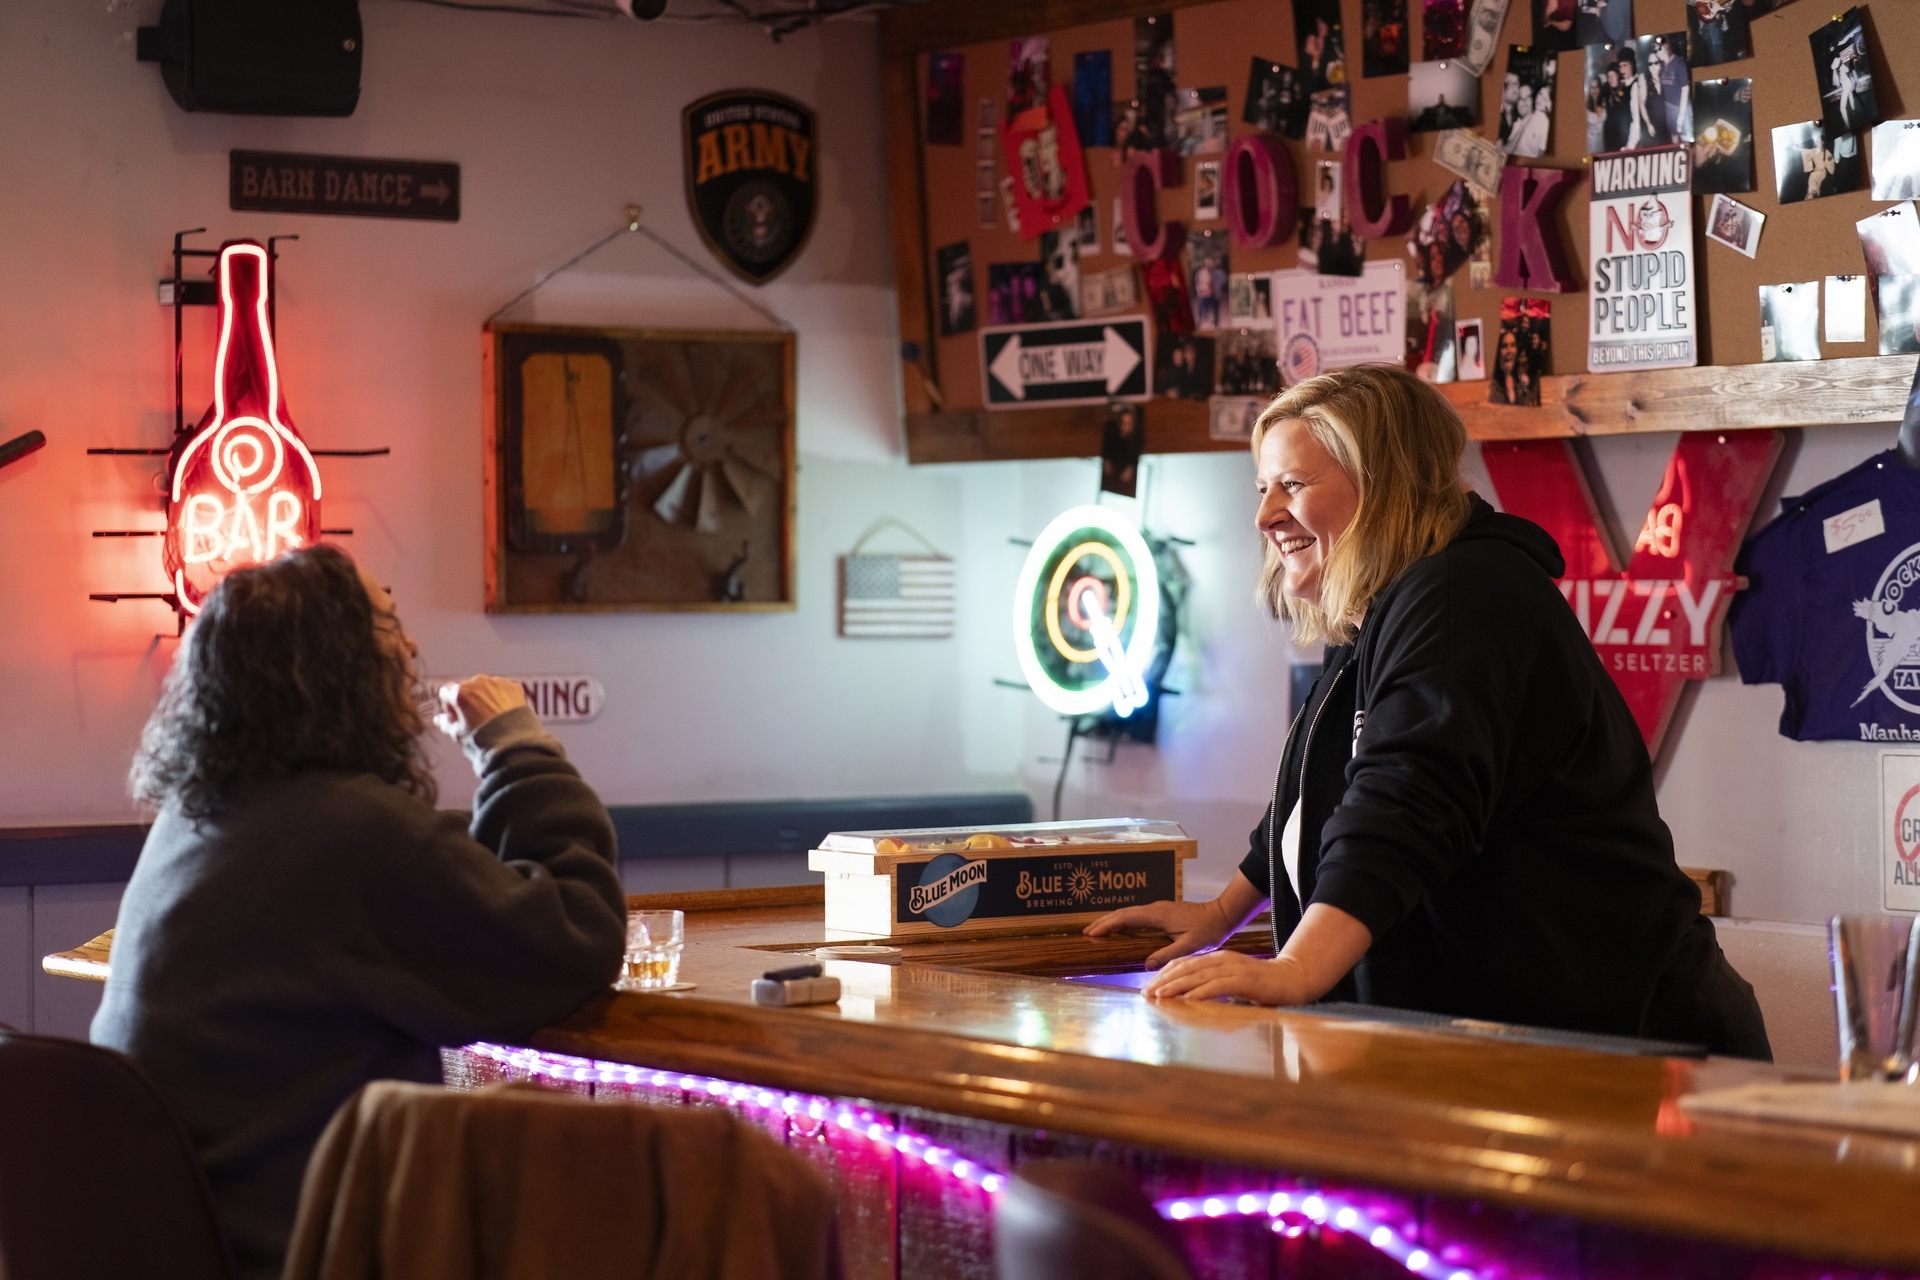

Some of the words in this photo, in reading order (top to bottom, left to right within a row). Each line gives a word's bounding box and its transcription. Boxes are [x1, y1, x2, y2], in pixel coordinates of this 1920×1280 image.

[697, 122, 810, 185] ARMY
[1593, 151, 1688, 193] WARNING
[242, 165, 315, 199] BARN
[324, 170, 414, 206] DANCE
[1606, 199, 1669, 253] NO
[1595, 250, 1686, 293] STUPID
[1282, 297, 1322, 338] FAT
[1338, 290, 1397, 337] BEEF
[1594, 291, 1687, 334] PEOPLE
[1018, 352, 1056, 380] ONE
[1062, 349, 1105, 377] WAY
[1593, 344, 1629, 364] BEYOND
[1631, 343, 1654, 362] THIS
[1656, 341, 1690, 360] POINT!
[183, 490, 303, 563] BAR
[1613, 653, 1706, 673] SELTZER
[1015, 871, 1063, 899] BLUE
[1099, 870, 1147, 890] MOON
[1053, 862, 1073, 870] ESTD
[1090, 860, 1109, 868] 1995
[910, 880, 947, 912] BLUE
[949, 863, 986, 892] MOON
[1026, 898, 1073, 908] BREWING
[1090, 895, 1136, 905] COMPANY
